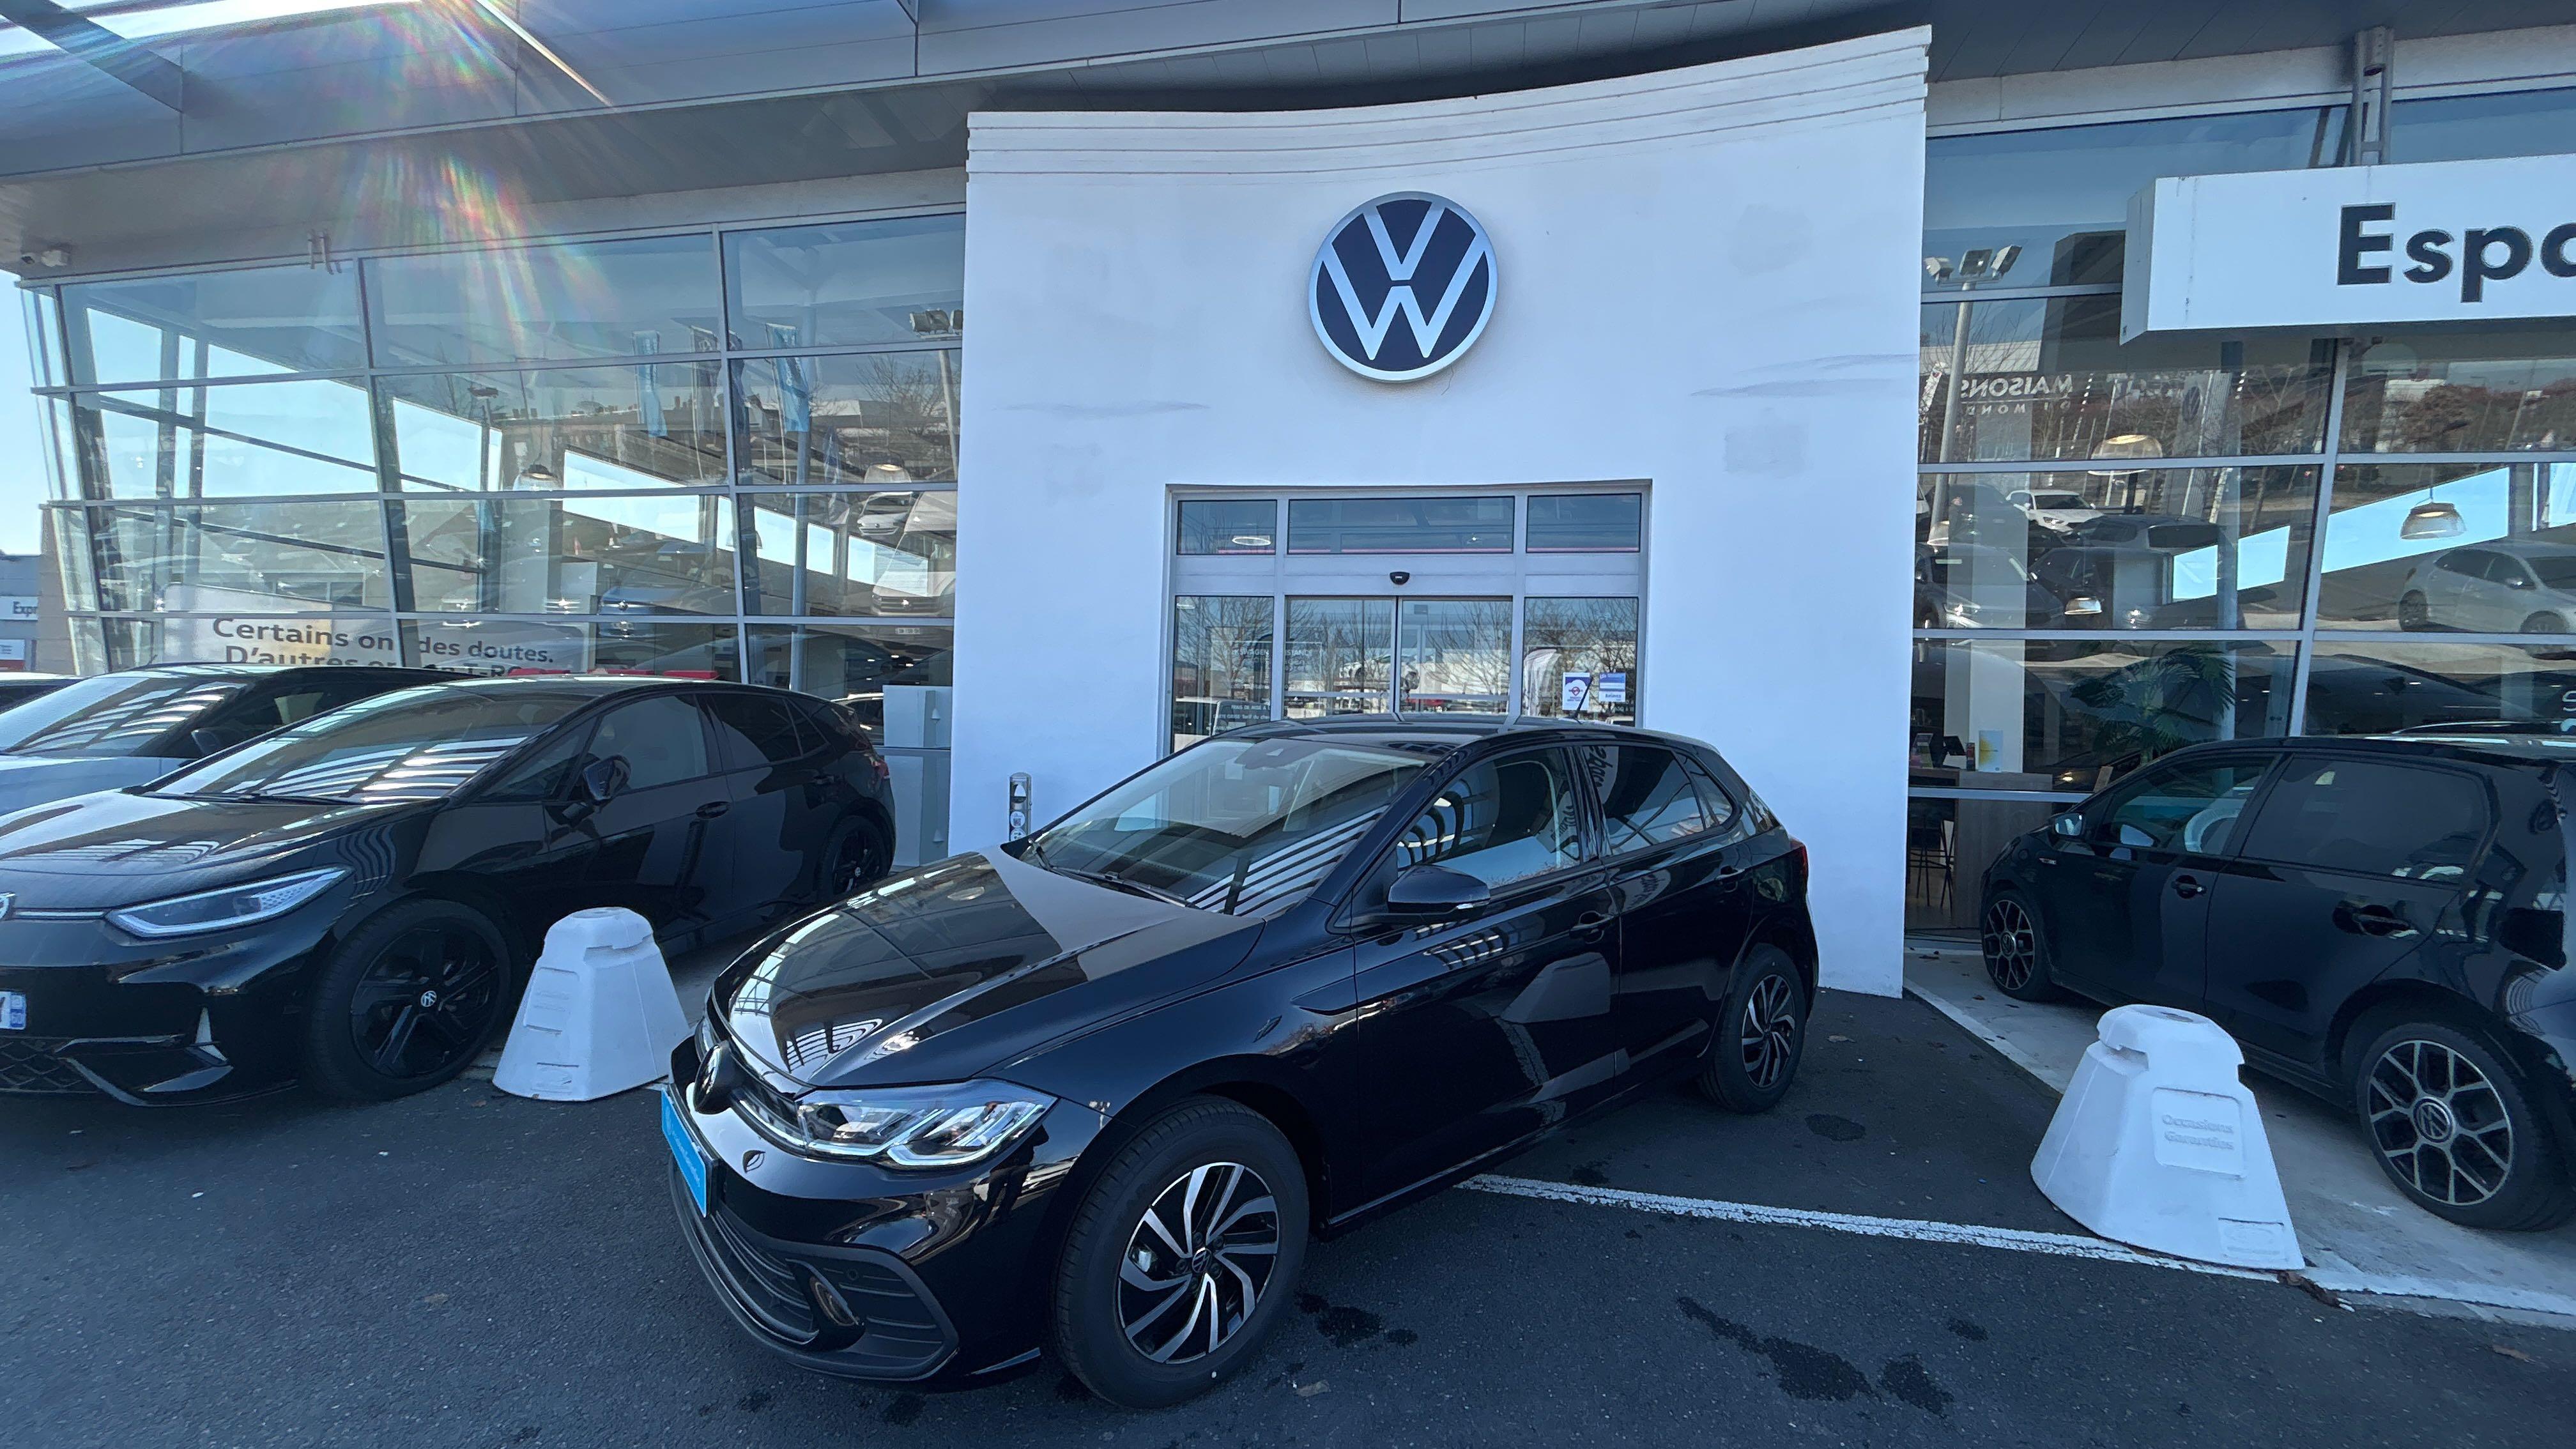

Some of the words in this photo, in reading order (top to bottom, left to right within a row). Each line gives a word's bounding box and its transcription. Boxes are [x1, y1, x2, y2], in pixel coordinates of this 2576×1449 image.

[213, 617, 349, 647] Certains
[358, 634, 394, 650] on
[419, 636, 460, 656] des
[468, 640, 554, 663] doutes.
[2162, 1114, 2234, 1134] Occasions
